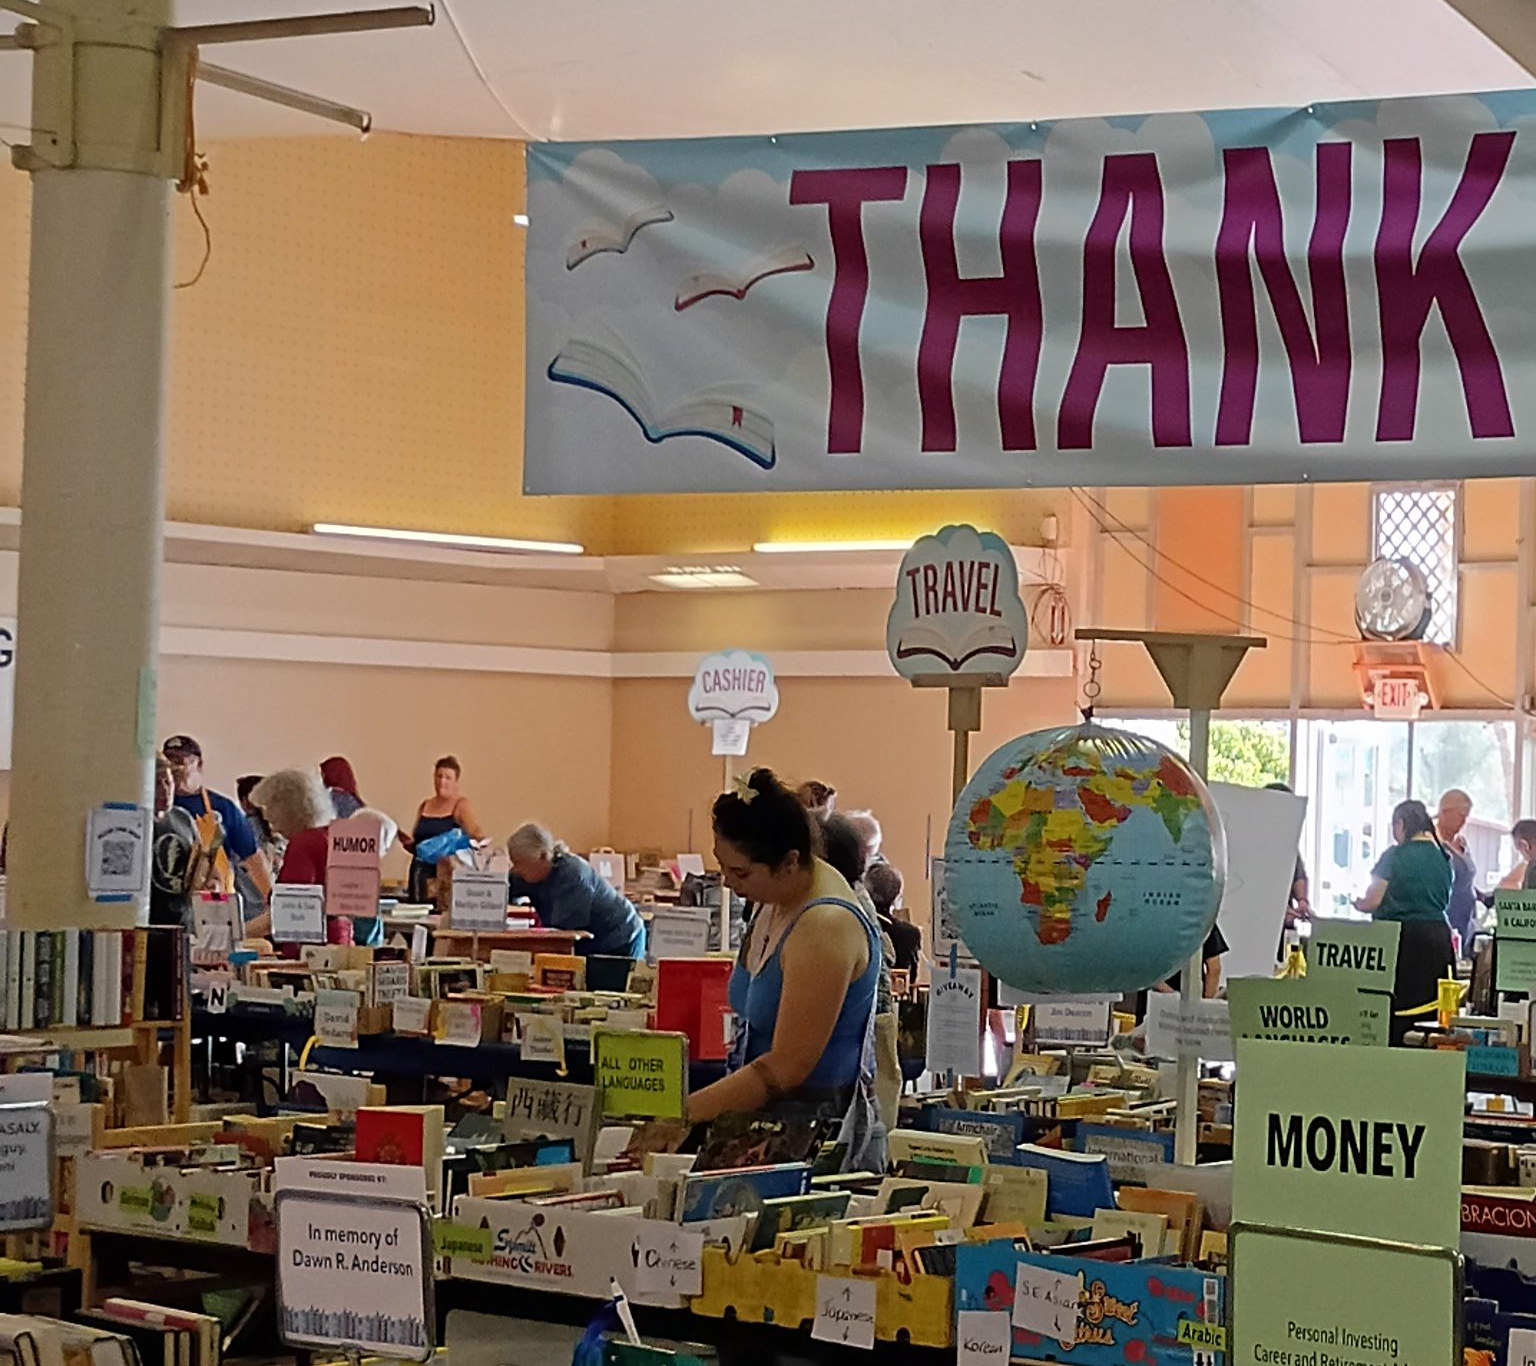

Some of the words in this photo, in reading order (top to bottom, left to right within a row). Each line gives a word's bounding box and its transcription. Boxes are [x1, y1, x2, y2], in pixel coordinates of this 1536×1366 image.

[790, 131, 1516, 455] THANK
[906, 560, 1002, 618] TRAVEL
[702, 668, 766, 695] CASHIER
[1382, 682, 1408, 706] EXIT
[333, 837, 376, 855] HUMOR
[1499, 901, 1521, 911] SANTA
[1316, 941, 1387, 972] TRAVEL
[210, 986, 224, 1006] N
[1260, 1004, 1329, 1029] WORLD
[601, 1057, 621, 1072] ALL
[629, 1057, 664, 1072] OTHER
[602, 1076, 665, 1093] LANGUAGES
[1267, 1112, 1426, 1179] MONEY
[308, 1224, 321, 1241] In
[324, 1227, 381, 1249] memory
[382, 1229, 399, 1246] of
[441, 1237, 484, 1253] Japanese
[292, 1249, 332, 1270] Dawn
[336, 1254, 348, 1271] R.
[351, 1256, 414, 1278] Anderson
[645, 1247, 697, 1272] Chinese
[1022, 1281, 1040, 1298] SE
[964, 1339, 1003, 1355] Korean
[1182, 1324, 1223, 1346] Arabic
[1288, 1321, 1339, 1346] Personal
[1342, 1328, 1399, 1357] Investing
[1254, 1344, 1291, 1366] Career
